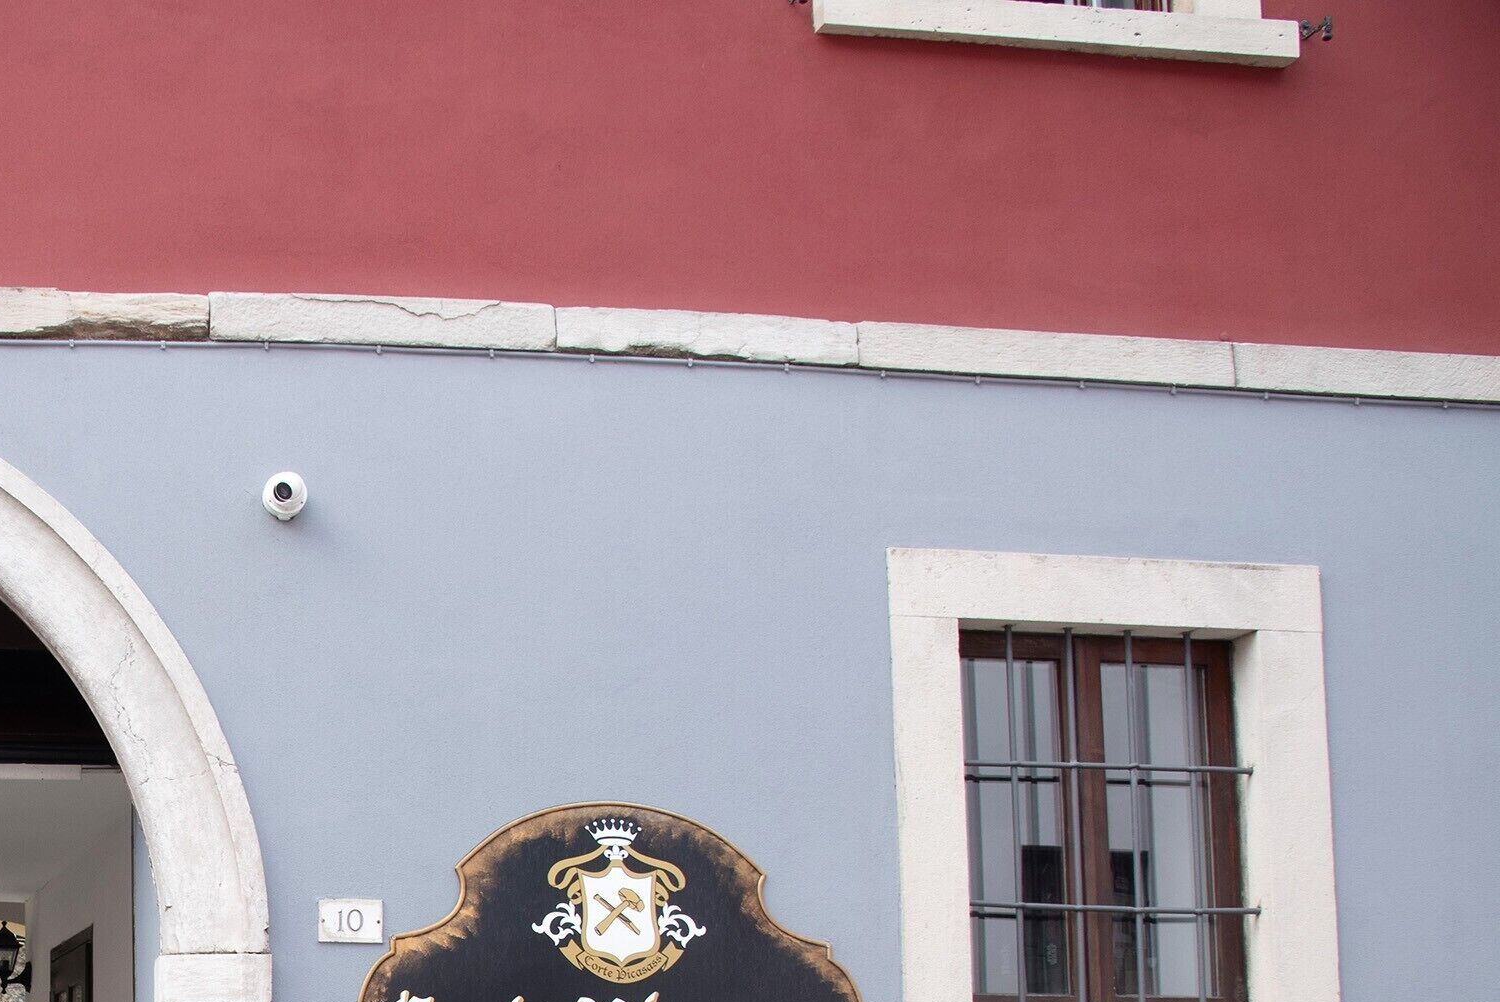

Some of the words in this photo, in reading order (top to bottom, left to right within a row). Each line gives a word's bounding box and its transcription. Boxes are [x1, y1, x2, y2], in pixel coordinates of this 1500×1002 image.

[337, 909, 364, 932] 10
[584, 955, 613, 978] Corte
[615, 955, 662, 981] Picasass
